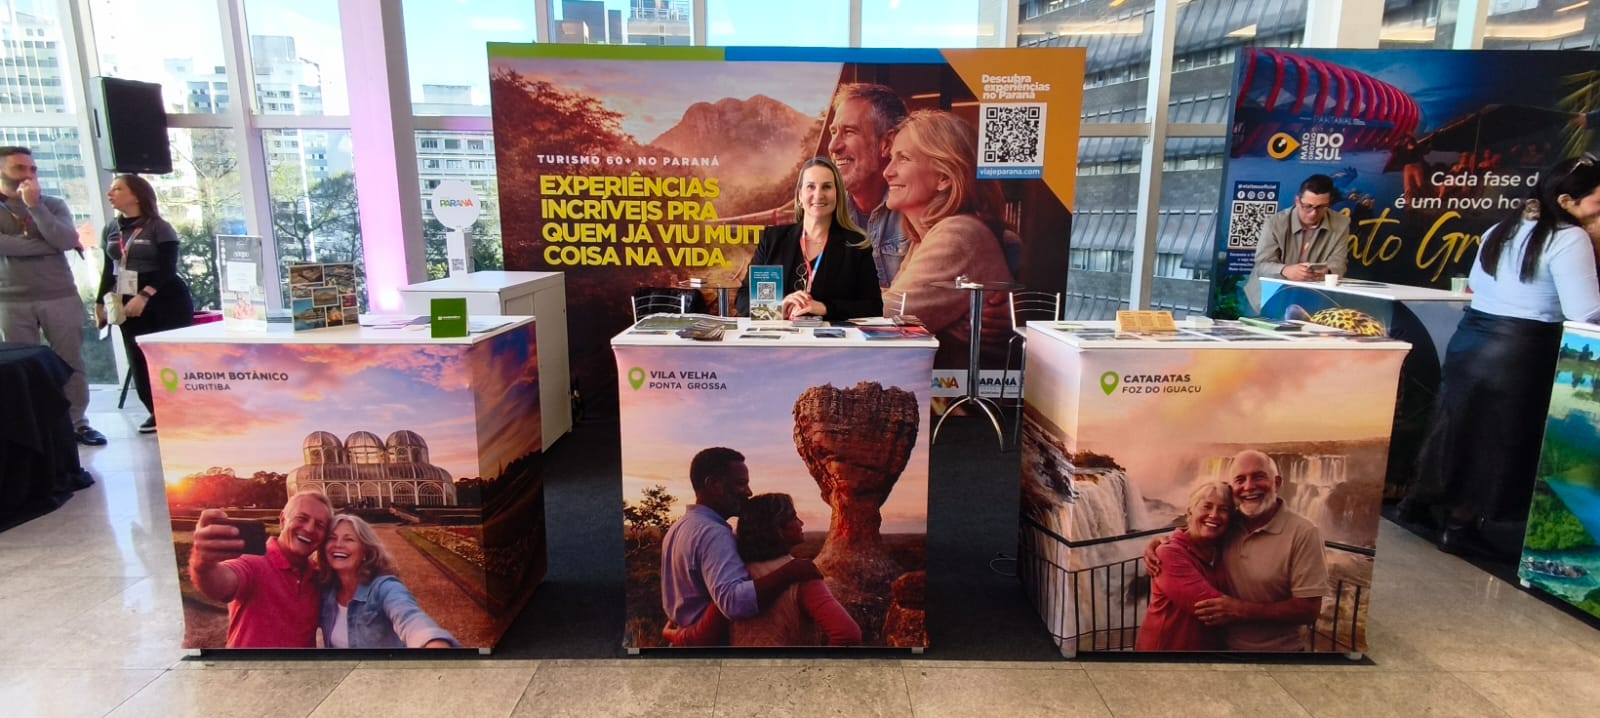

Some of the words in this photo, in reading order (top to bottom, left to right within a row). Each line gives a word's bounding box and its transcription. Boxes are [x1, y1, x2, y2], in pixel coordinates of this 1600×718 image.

[982, 74, 1032, 84] Descubra
[984, 82, 1051, 93] experiências
[983, 92, 997, 100] no
[999, 91, 1036, 100] Paraná
[1301, 132, 1310, 160] MATO
[1316, 133, 1344, 148] DO
[1315, 148, 1342, 160] SUL
[537, 154, 600, 165] TURISMO
[606, 156, 632, 166] 60+
[638, 156, 658, 166] NO
[663, 154, 720, 167] PARANÁ
[979, 167, 1041, 177] viajeparana.com
[539, 171, 720, 198] EXPERIÊNCIAS
[1430, 171, 1478, 187] Cada
[1482, 171, 1521, 187] fase
[1525, 172, 1540, 187] d
[1394, 193, 1406, 209] é
[1411, 197, 1442, 209] um
[1447, 197, 1493, 209] novo
[541, 196, 663, 221] INCRÍVEIS
[668, 201, 719, 221] PRA
[542, 222, 617, 244] QUEM
[621, 218, 654, 244] JÁ
[656, 223, 700, 244] VIU
[704, 224, 765, 245] MUIT
[1341, 207, 1403, 266] ato
[544, 246, 621, 266] COISA
[625, 247, 664, 266] NA
[666, 247, 733, 268] VIDA.
[183, 371, 226, 380] JARDIM
[228, 369, 289, 381] BOTÂNICO
[650, 370, 676, 379] VILA
[679, 371, 717, 380] VELHA
[979, 376, 1018, 386] ARANÁ
[1123, 374, 1191, 383] CATARATAS
[185, 383, 231, 391] CURITIBA
[687, 382, 727, 390] GROSSA
[1122, 386, 1142, 394] FOZ
[1145, 386, 1160, 394] DO
[1163, 385, 1202, 395] IGUAÇU
